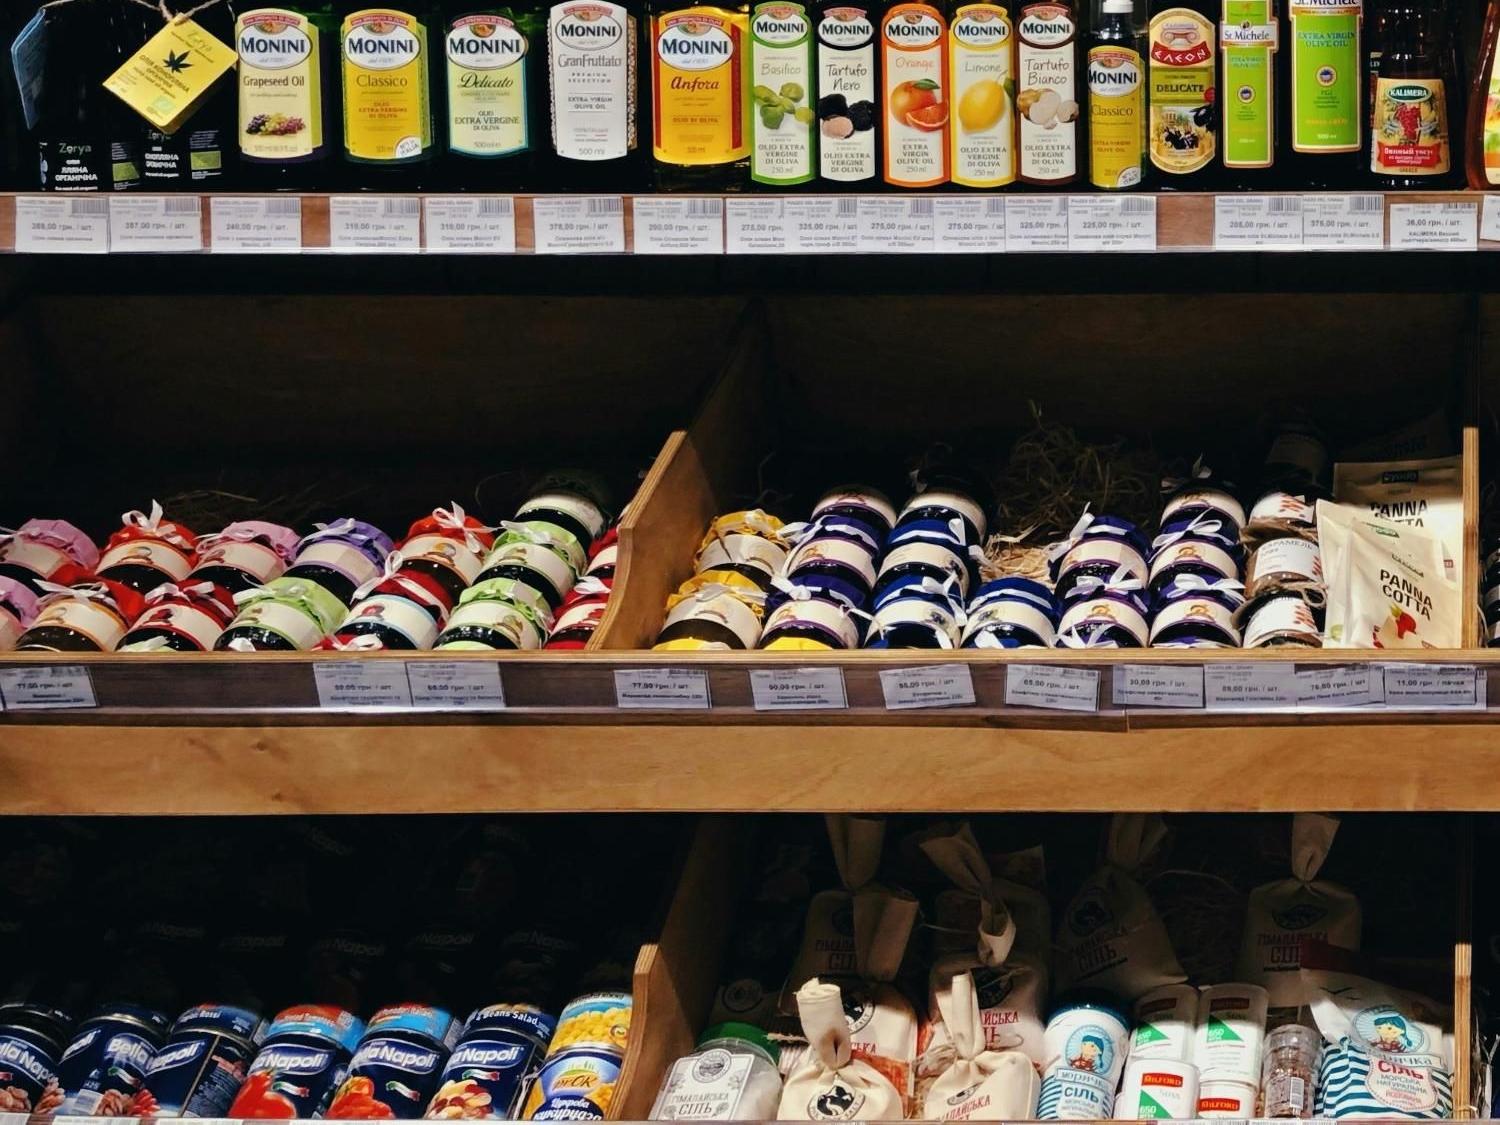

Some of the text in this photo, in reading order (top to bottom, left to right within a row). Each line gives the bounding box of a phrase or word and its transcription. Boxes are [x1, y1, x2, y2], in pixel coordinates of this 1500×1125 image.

[560, 24, 616, 37] MONINI
[1236, 30, 1269, 40] Michele
[1297, 32, 1325, 40] EXTRA
[241, 39, 305, 53] MONINI
[349, 39, 413, 54] MONINI
[450, 39, 521, 54] MONINI
[662, 39, 728, 54] MONINI
[559, 53, 622, 68] GranFruttato
[896, 57, 934, 70] Orange
[965, 62, 1001, 73] Limone
[1024, 58, 1070, 72] Tartufo
[761, 62, 801, 76] Basilico
[826, 63, 867, 77] Tartufo
[244, 75, 305, 88] Grapeseed Oil
[356, 75, 408, 87] Classico
[458, 72, 514, 88] Delicato
[671, 76, 720, 92] Anfora
[833, 78, 860, 91] Nero
[1028, 73, 1067, 85] Bianco
[1156, 84, 1204, 93] DELICATE
[1389, 88, 1428, 97] KALIMERA
[1092, 105, 1133, 117] Classico
[58, 143, 92, 155] Zorya
[1380, 569, 1433, 609] PANNA
[1383, 585, 1431, 620] COTTA
[484, 1010, 538, 1024] Beans Salad
[108, 1039, 148, 1063] Bella
[266, 1053, 324, 1068] Napoli
[383, 1048, 436, 1069] Napoli
[1064, 1086, 1099, 1103] СІЛЬ
[678, 1102, 712, 1116] СІЛЬ
[1139, 1106, 1158, 1118] 650
